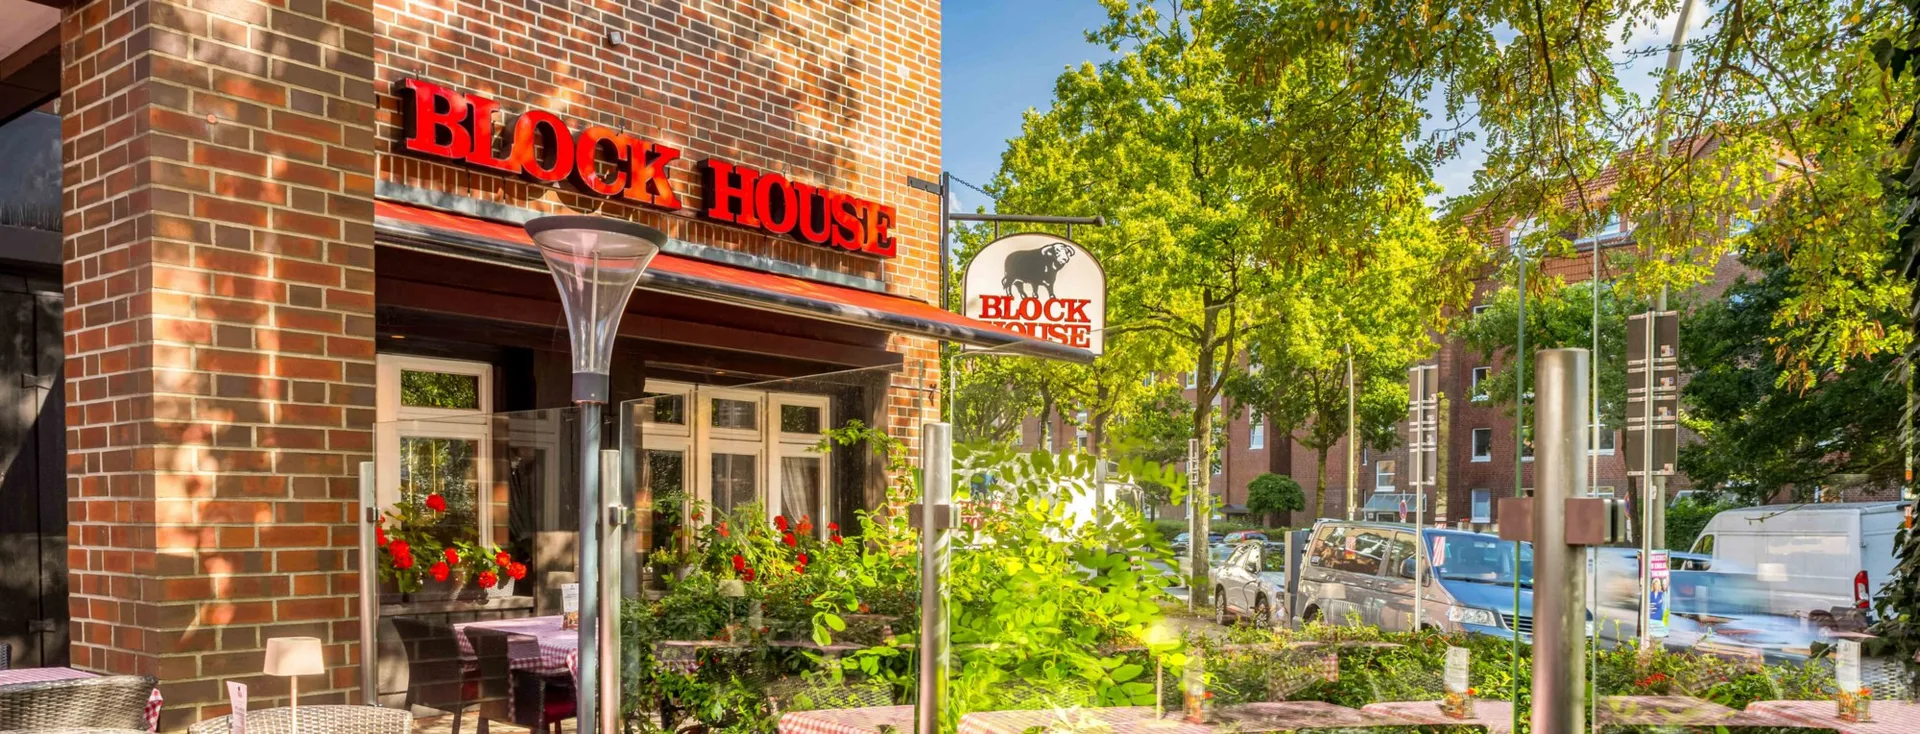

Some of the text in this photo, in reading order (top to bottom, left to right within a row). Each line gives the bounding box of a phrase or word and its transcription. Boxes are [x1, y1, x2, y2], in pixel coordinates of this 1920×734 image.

[403, 77, 897, 259] BLOCK HOUSE
[979, 295, 1091, 323] BLOCK
[985, 321, 1091, 348] OUSE
